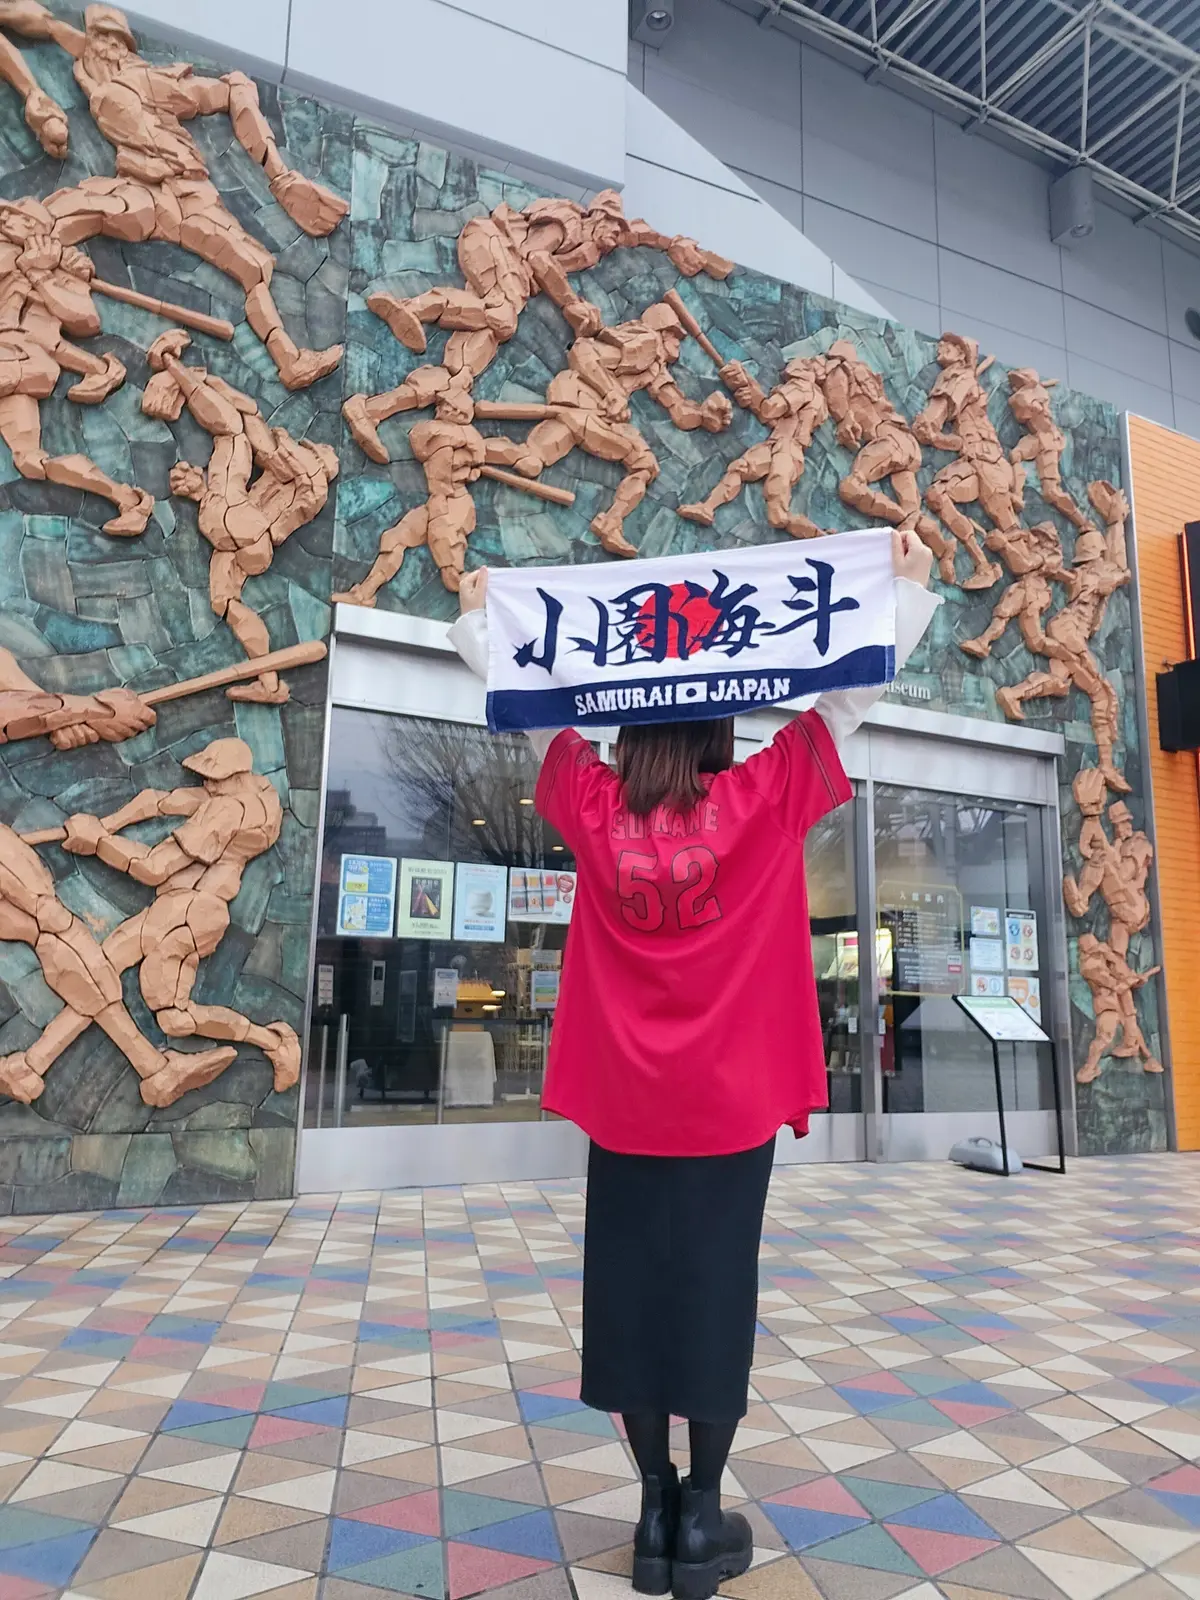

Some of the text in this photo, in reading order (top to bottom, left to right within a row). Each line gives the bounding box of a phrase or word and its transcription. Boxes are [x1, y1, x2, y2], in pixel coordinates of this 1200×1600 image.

[512, 557, 860, 676] 小園海斗
[574, 677, 791, 716] SAMURAI JAPAN
[886, 681, 931, 700] useum
[610, 801, 720, 840] SUKANE
[616, 845, 723, 933] 52
